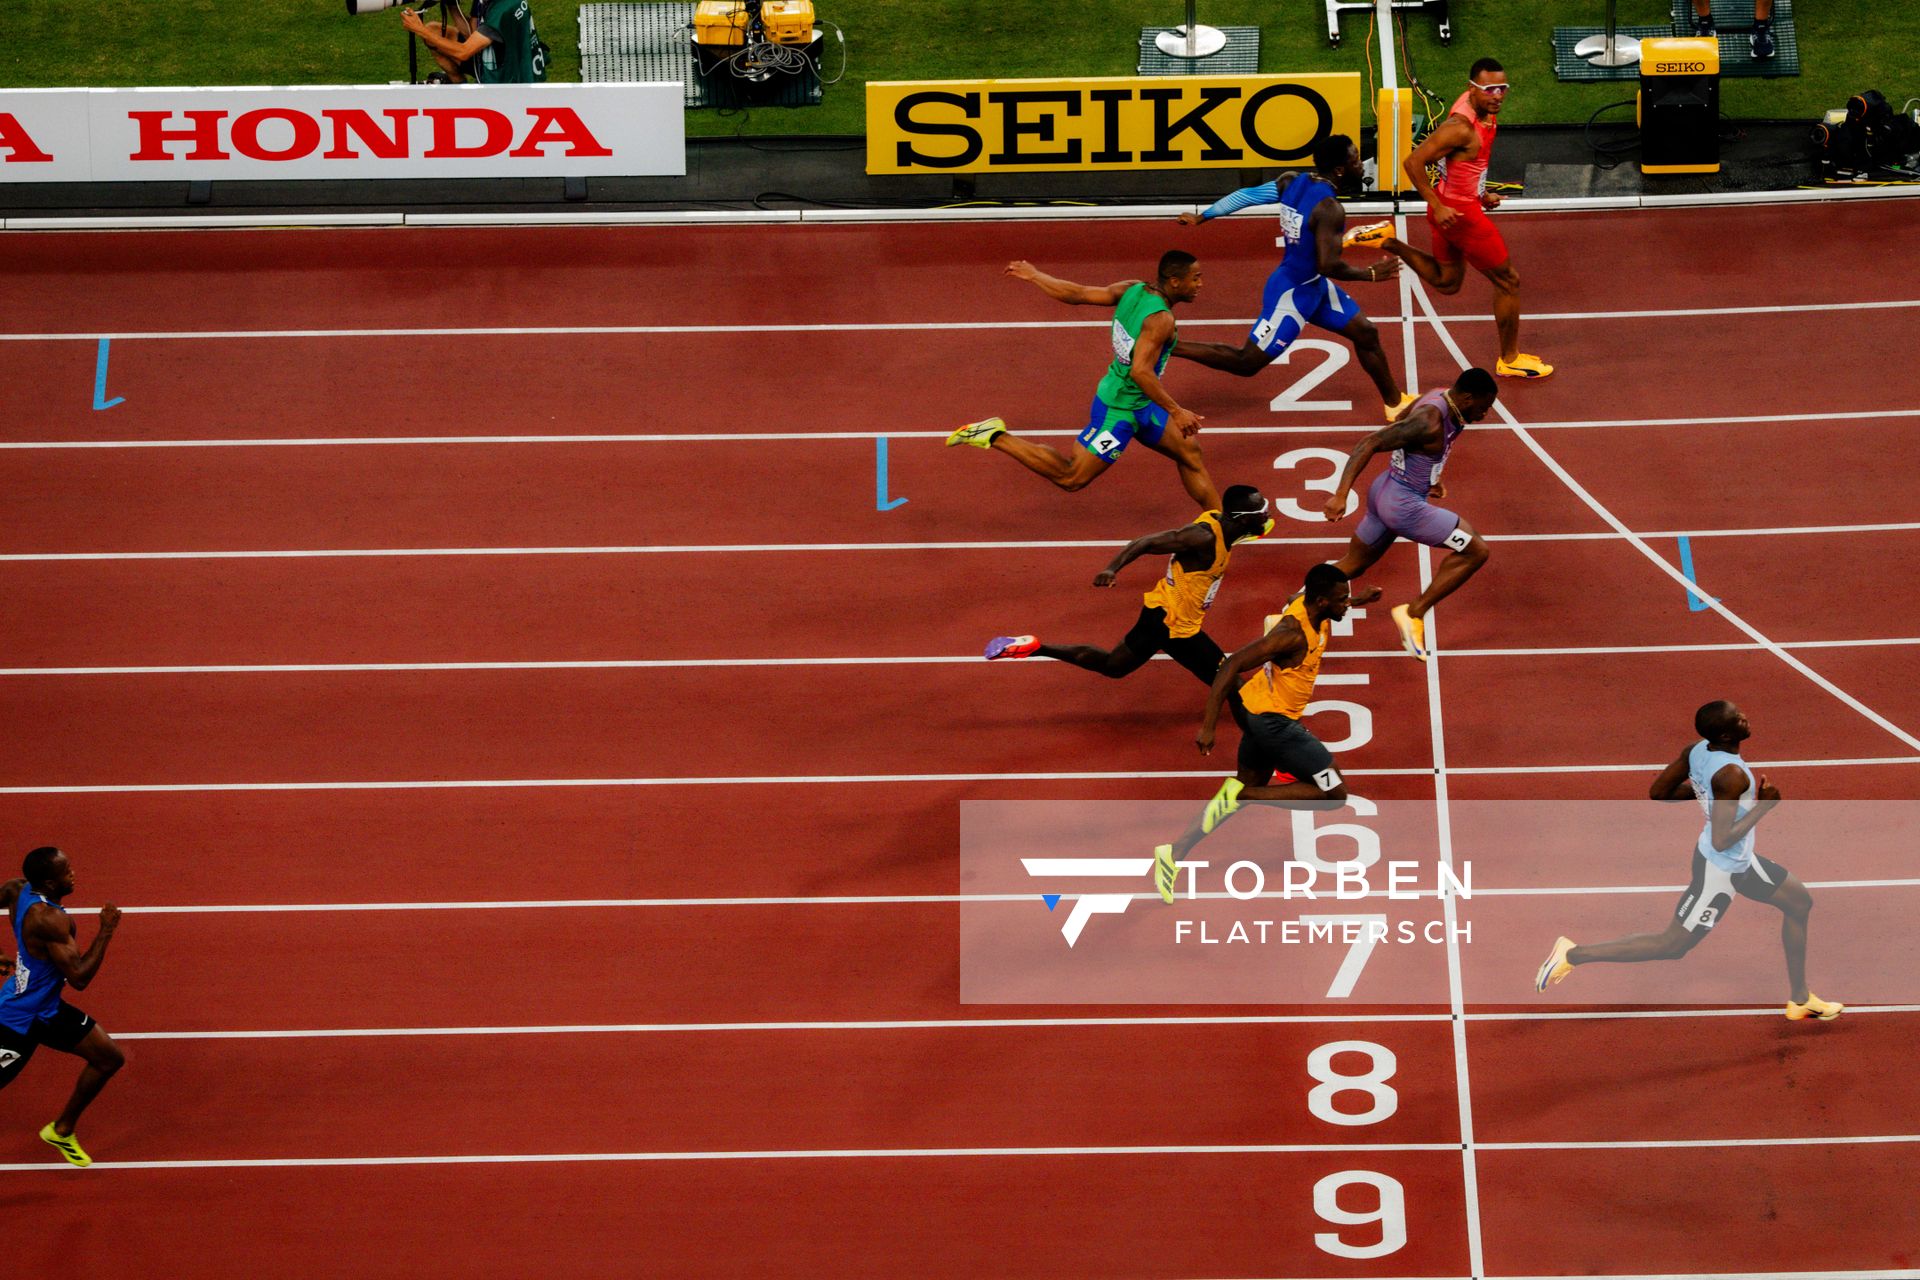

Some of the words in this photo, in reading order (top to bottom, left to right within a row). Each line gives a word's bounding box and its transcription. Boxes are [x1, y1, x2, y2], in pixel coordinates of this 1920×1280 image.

[1656, 62, 1705, 72] SEIKO
[128, 107, 613, 161] HONDA
[894, 84, 1333, 168] SEIKO
[1269, 338, 1353, 412] 2
[1100, 440, 1112, 450] 4
[1273, 448, 1359, 522] 3
[1452, 535, 1465, 547] 5
[1320, 771, 1331, 787] 7
[1291, 794, 1381, 875] 6
[1700, 910, 1712, 922] 8
[1299, 914, 1387, 998] 7
[1306, 1040, 1398, 1126] 8
[1312, 1170, 1407, 1259] 9
